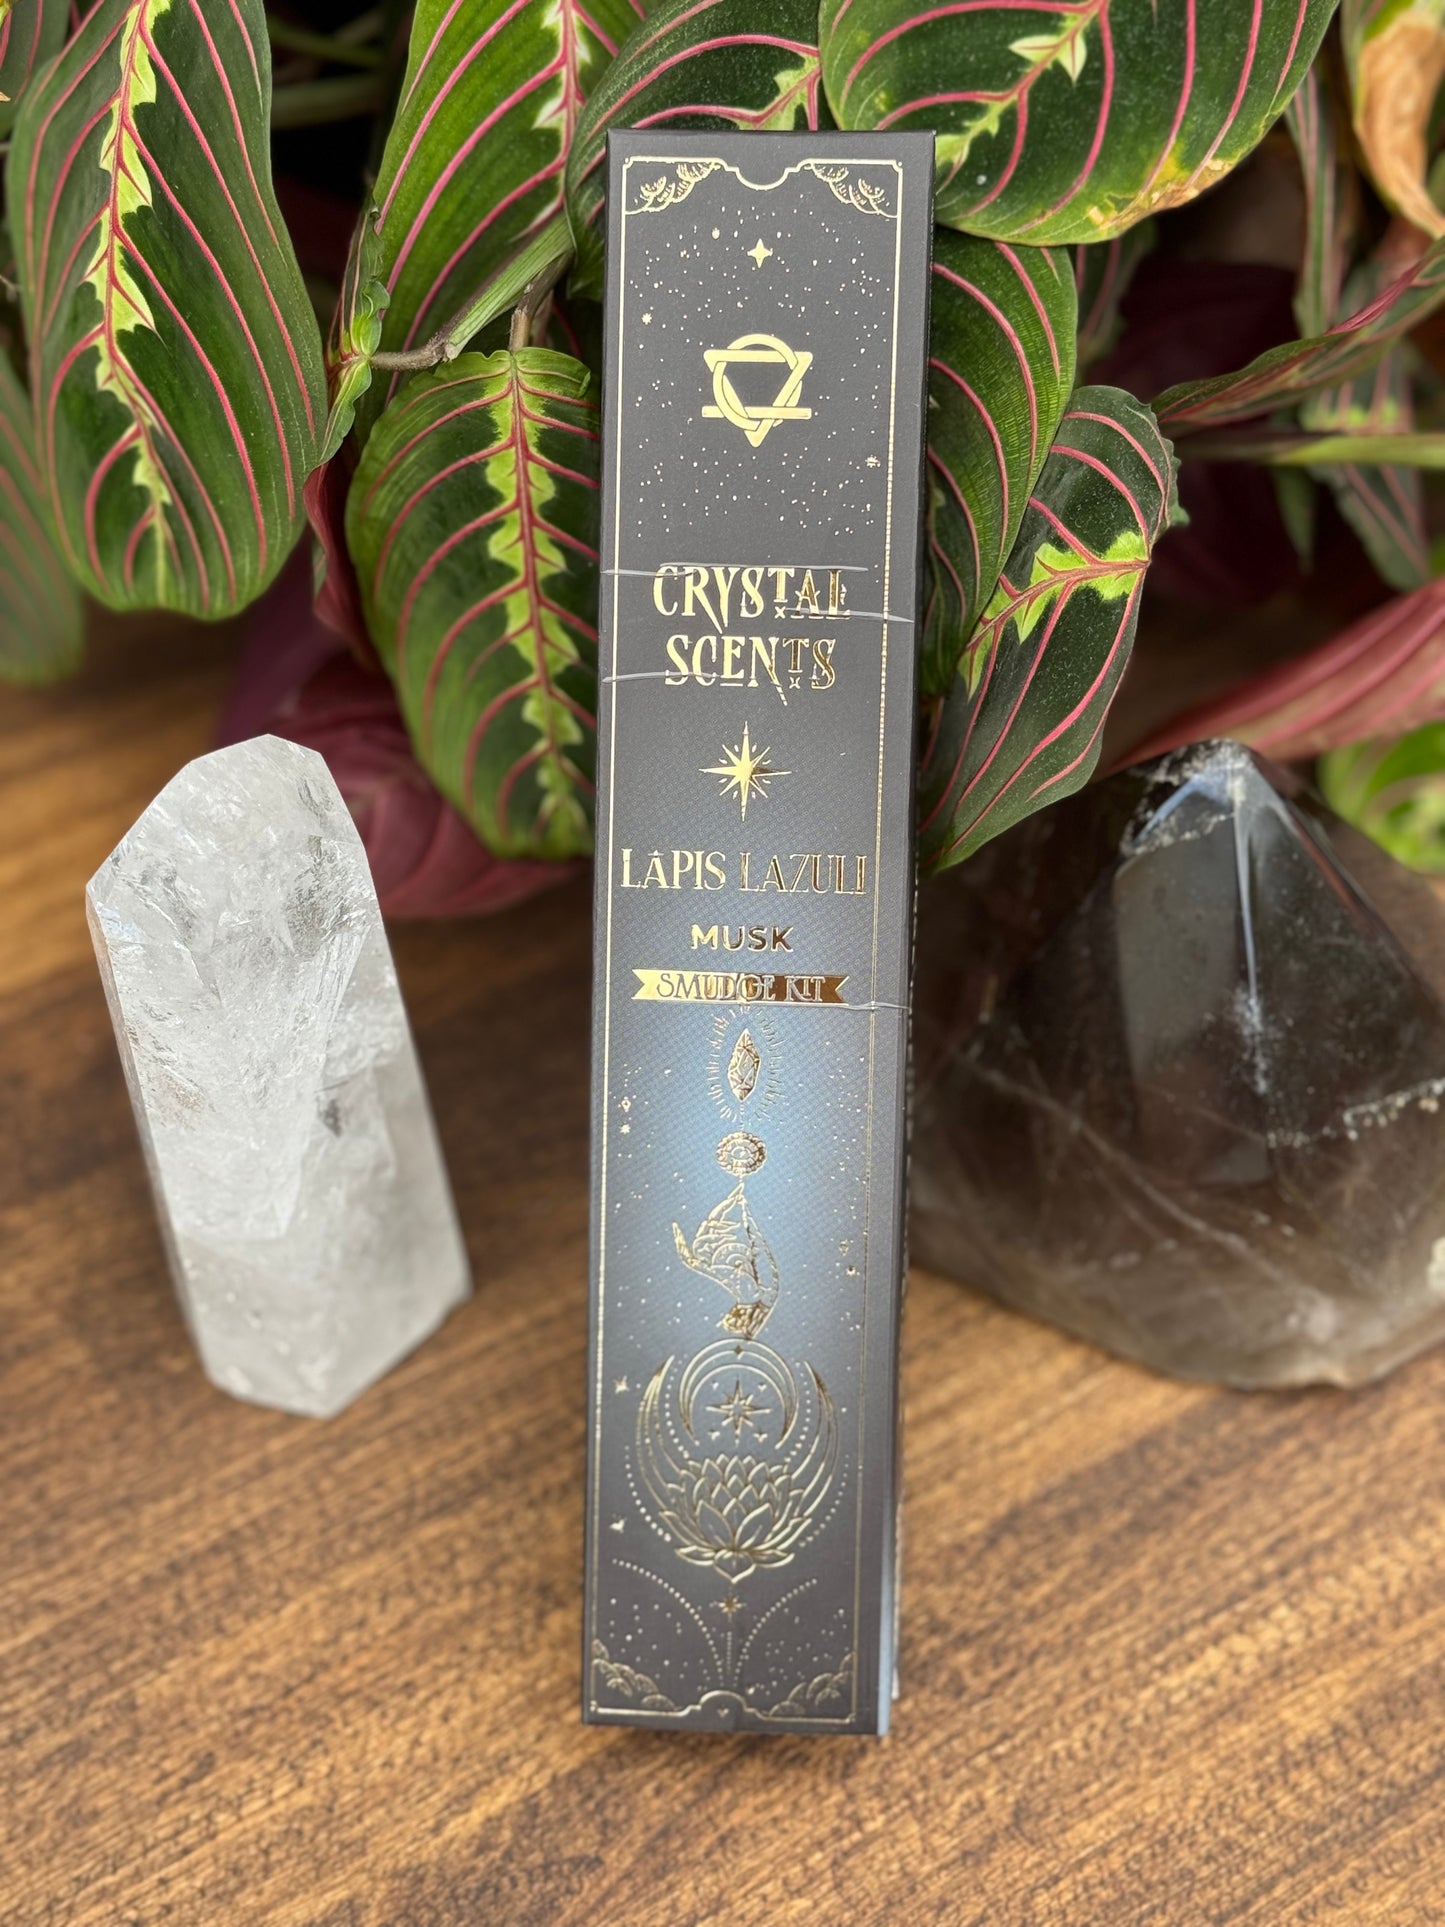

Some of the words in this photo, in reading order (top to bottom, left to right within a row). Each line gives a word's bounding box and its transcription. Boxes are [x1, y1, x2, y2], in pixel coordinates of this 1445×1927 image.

[653, 565, 851, 634] CRYSTAL
[664, 634, 836, 706] SCENTS
[620, 848, 726, 891] LAPIS
[739, 852, 867, 895] LAZULI
[691, 924, 794, 952] MUSK
[656, 972, 776, 1001] SMUDGE
[785, 975, 826, 1002] KIT
